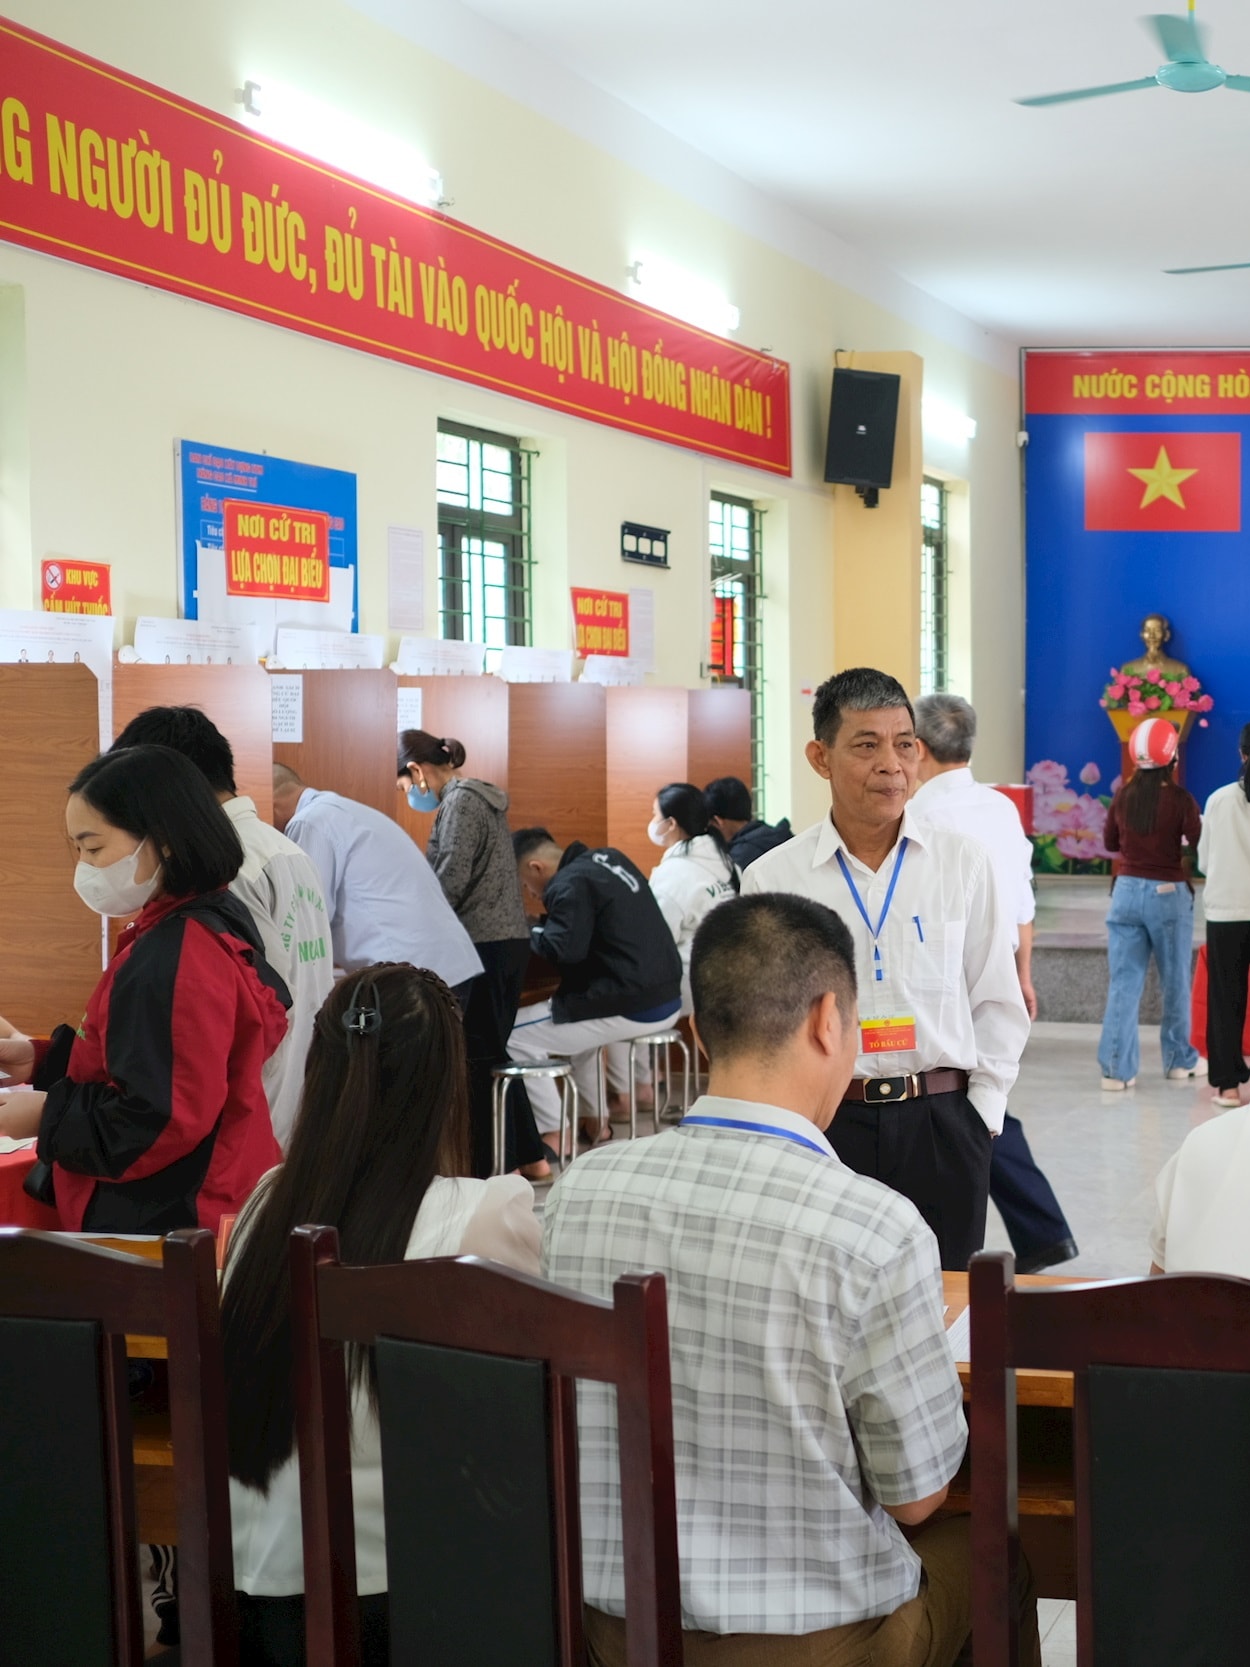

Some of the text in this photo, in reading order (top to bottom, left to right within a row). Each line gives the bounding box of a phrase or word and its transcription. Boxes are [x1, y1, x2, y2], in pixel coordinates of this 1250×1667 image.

[45, 112, 174, 235] NGƯỜI
[184, 149, 232, 254] ĐỦ
[241, 183, 317, 294] ĐỨC,
[324, 206, 364, 301] ĐỦ
[370, 236, 414, 319] TÀI
[419, 255, 468, 337] VÀO
[474, 278, 534, 360] QUỐC
[539, 304, 574, 384] HỘI
[577, 319, 604, 385] VÀ
[607, 331, 638, 406] HỘI
[641, 338, 687, 412] ĐỒNG
[690, 365, 732, 426] NHÂN
[734, 378, 763, 437] DÂN
[1073, 368, 1137, 398] NƯỚC
[1145, 370, 1211, 403] CỘNG
[237, 514, 265, 539] NƠI
[269, 513, 291, 541] CỬ
[293, 522, 316, 546] TRI
[66, 569, 98, 590] KHU VỰC
[231, 547, 323, 592] LỰA CHỌN ĐẠI BIỂU
[577, 595, 622, 618] NƠI CỬ TRI
